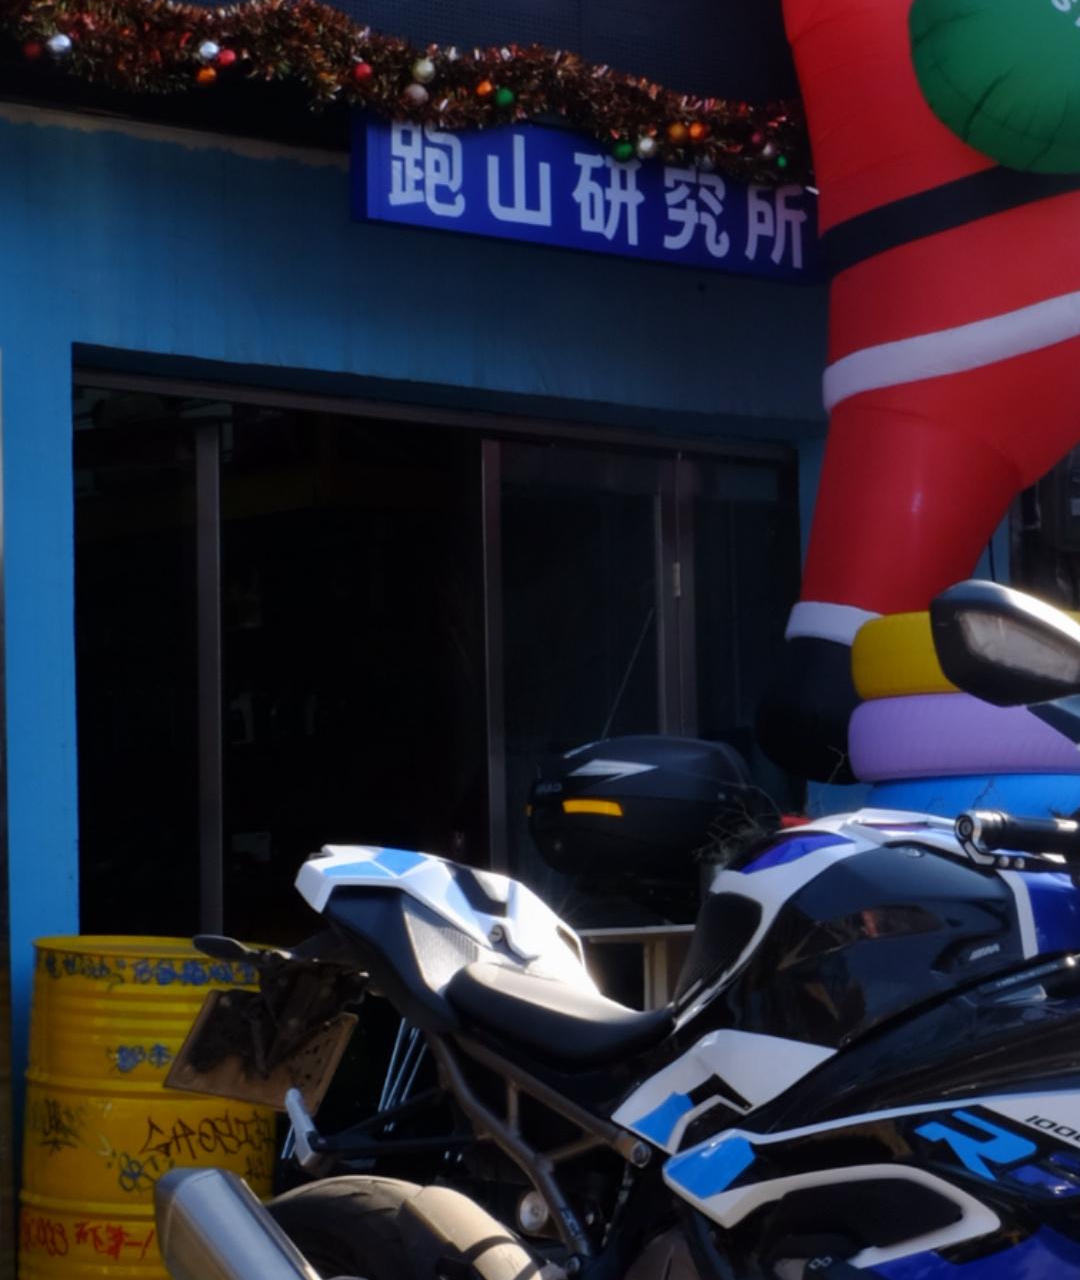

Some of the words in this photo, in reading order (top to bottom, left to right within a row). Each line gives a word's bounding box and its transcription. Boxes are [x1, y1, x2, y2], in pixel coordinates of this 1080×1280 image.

[388, 121, 808, 269] 跑山研究所
